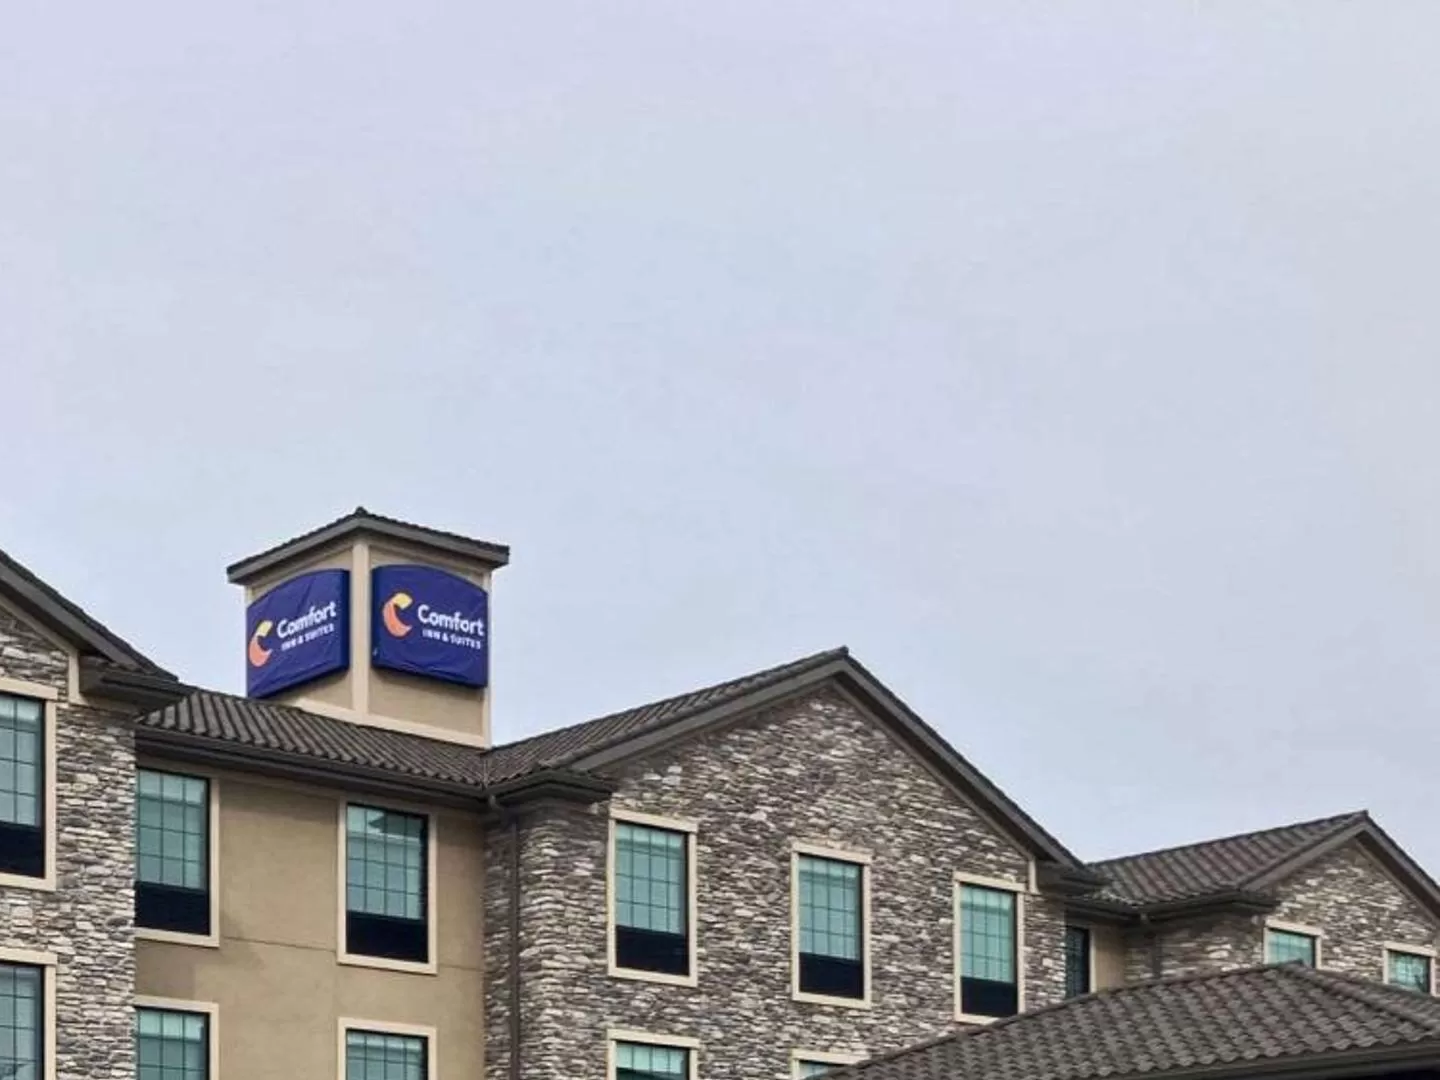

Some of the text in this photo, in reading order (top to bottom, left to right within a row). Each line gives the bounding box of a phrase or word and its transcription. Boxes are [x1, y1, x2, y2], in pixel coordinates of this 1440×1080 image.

[277, 601, 336, 638] Comfort
[417, 604, 484, 636] Comfort
[422, 628, 481, 650] INN & SUITES
